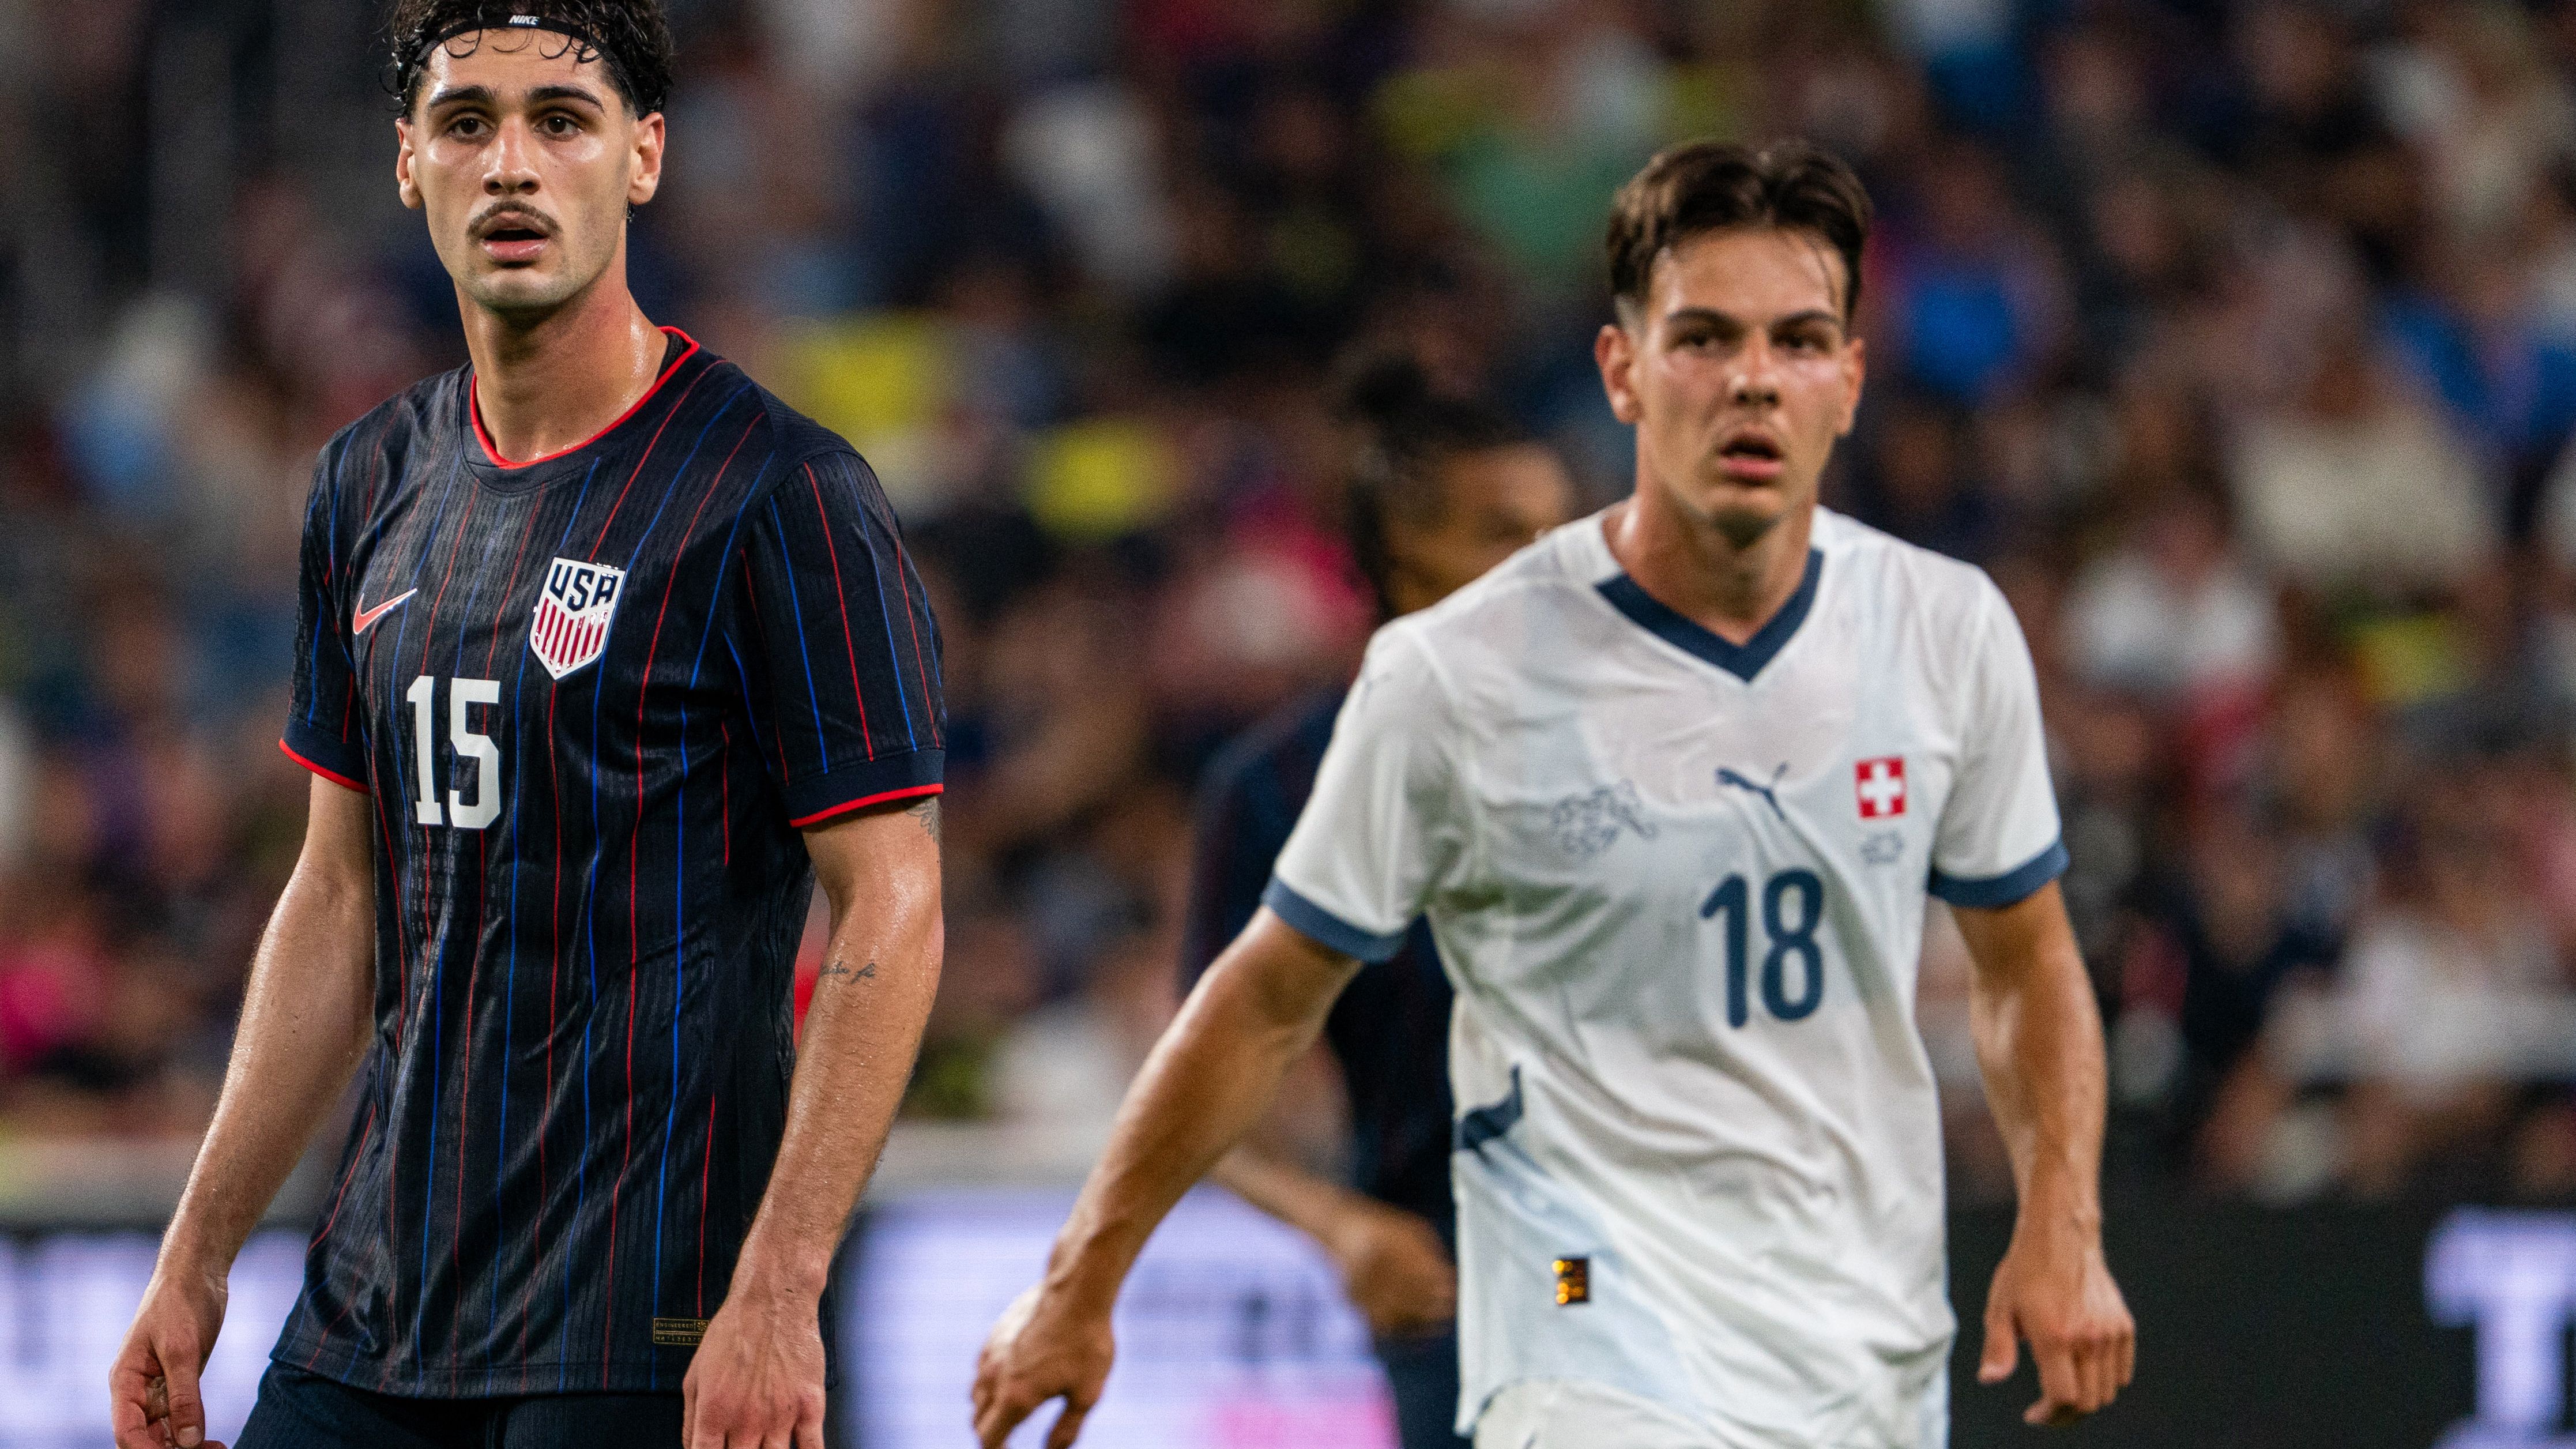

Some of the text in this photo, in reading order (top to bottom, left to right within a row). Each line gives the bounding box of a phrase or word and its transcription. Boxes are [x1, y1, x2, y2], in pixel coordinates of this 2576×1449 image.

[509, 15, 540, 25] NIKE
[549, 563, 619, 612] USA
[406, 676, 500, 829] 15
[1699, 868, 1824, 1028] 18
